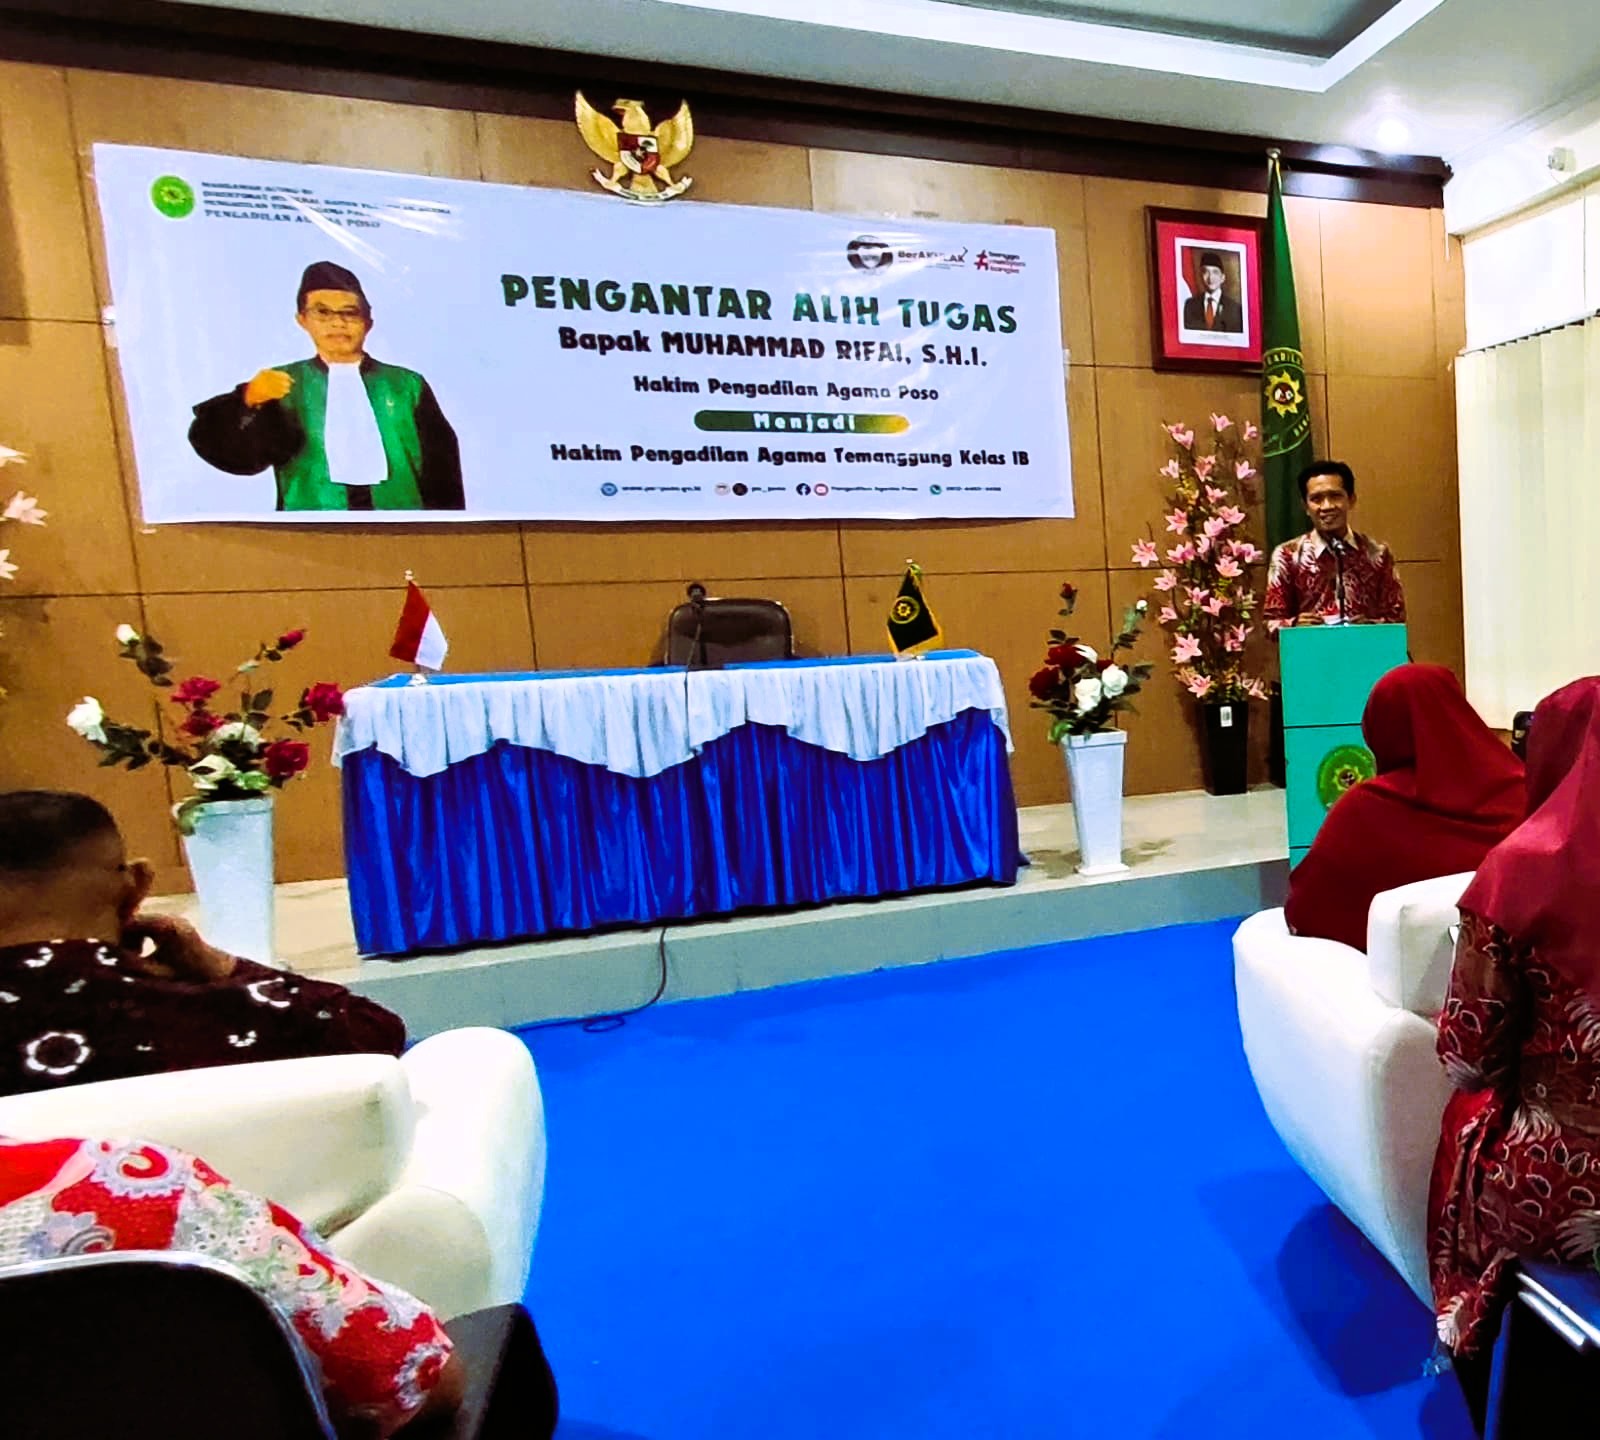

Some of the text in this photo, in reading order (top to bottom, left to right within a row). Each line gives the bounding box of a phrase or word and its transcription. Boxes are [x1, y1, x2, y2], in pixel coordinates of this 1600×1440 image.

[501, 274, 1018, 333] PENGANTAR ALIH TUGAS
[558, 326, 988, 367] Bapak MUHAMMAD RIFAI, S.H.I.
[633, 375, 939, 401] Hakim Pengadilan Agama Poso
[753, 413, 856, 433] Menjadi
[550, 444, 1029, 467] Hakim Pengadilan Agama Temanggung Kelas IB
